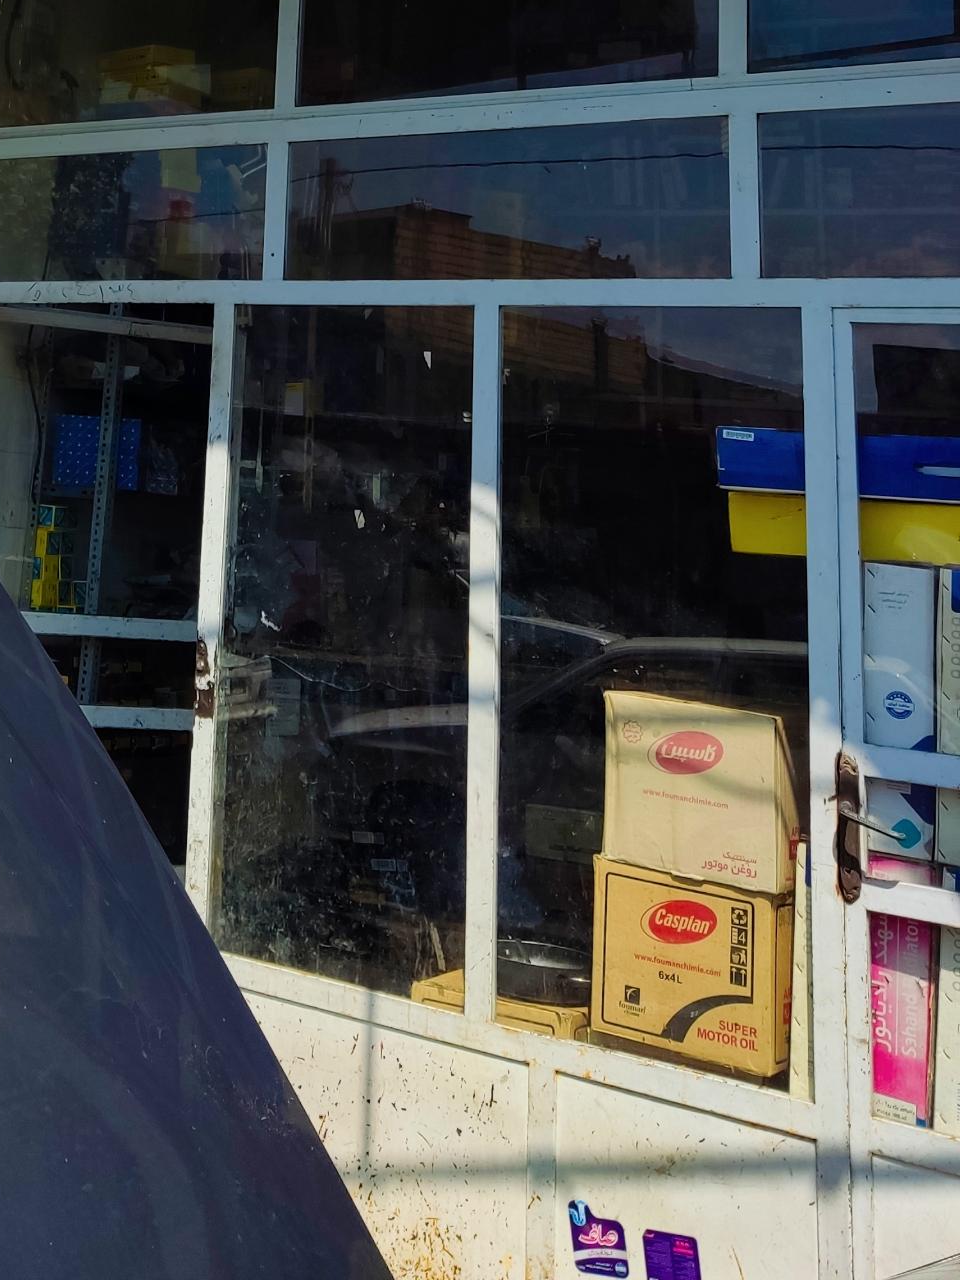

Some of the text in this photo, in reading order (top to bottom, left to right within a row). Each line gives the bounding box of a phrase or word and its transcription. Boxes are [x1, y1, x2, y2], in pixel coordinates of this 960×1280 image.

[661, 741, 718, 763] کاسپین
[701, 859, 758, 879] روغن موتور
[655, 908, 710, 935] Caspian
[871, 969, 893, 1054] رادیاتور
[901, 991, 919, 1058] Sahand
[696, 1026, 759, 1052] MOTOR OIL
[718, 1019, 758, 1039] SUPER
